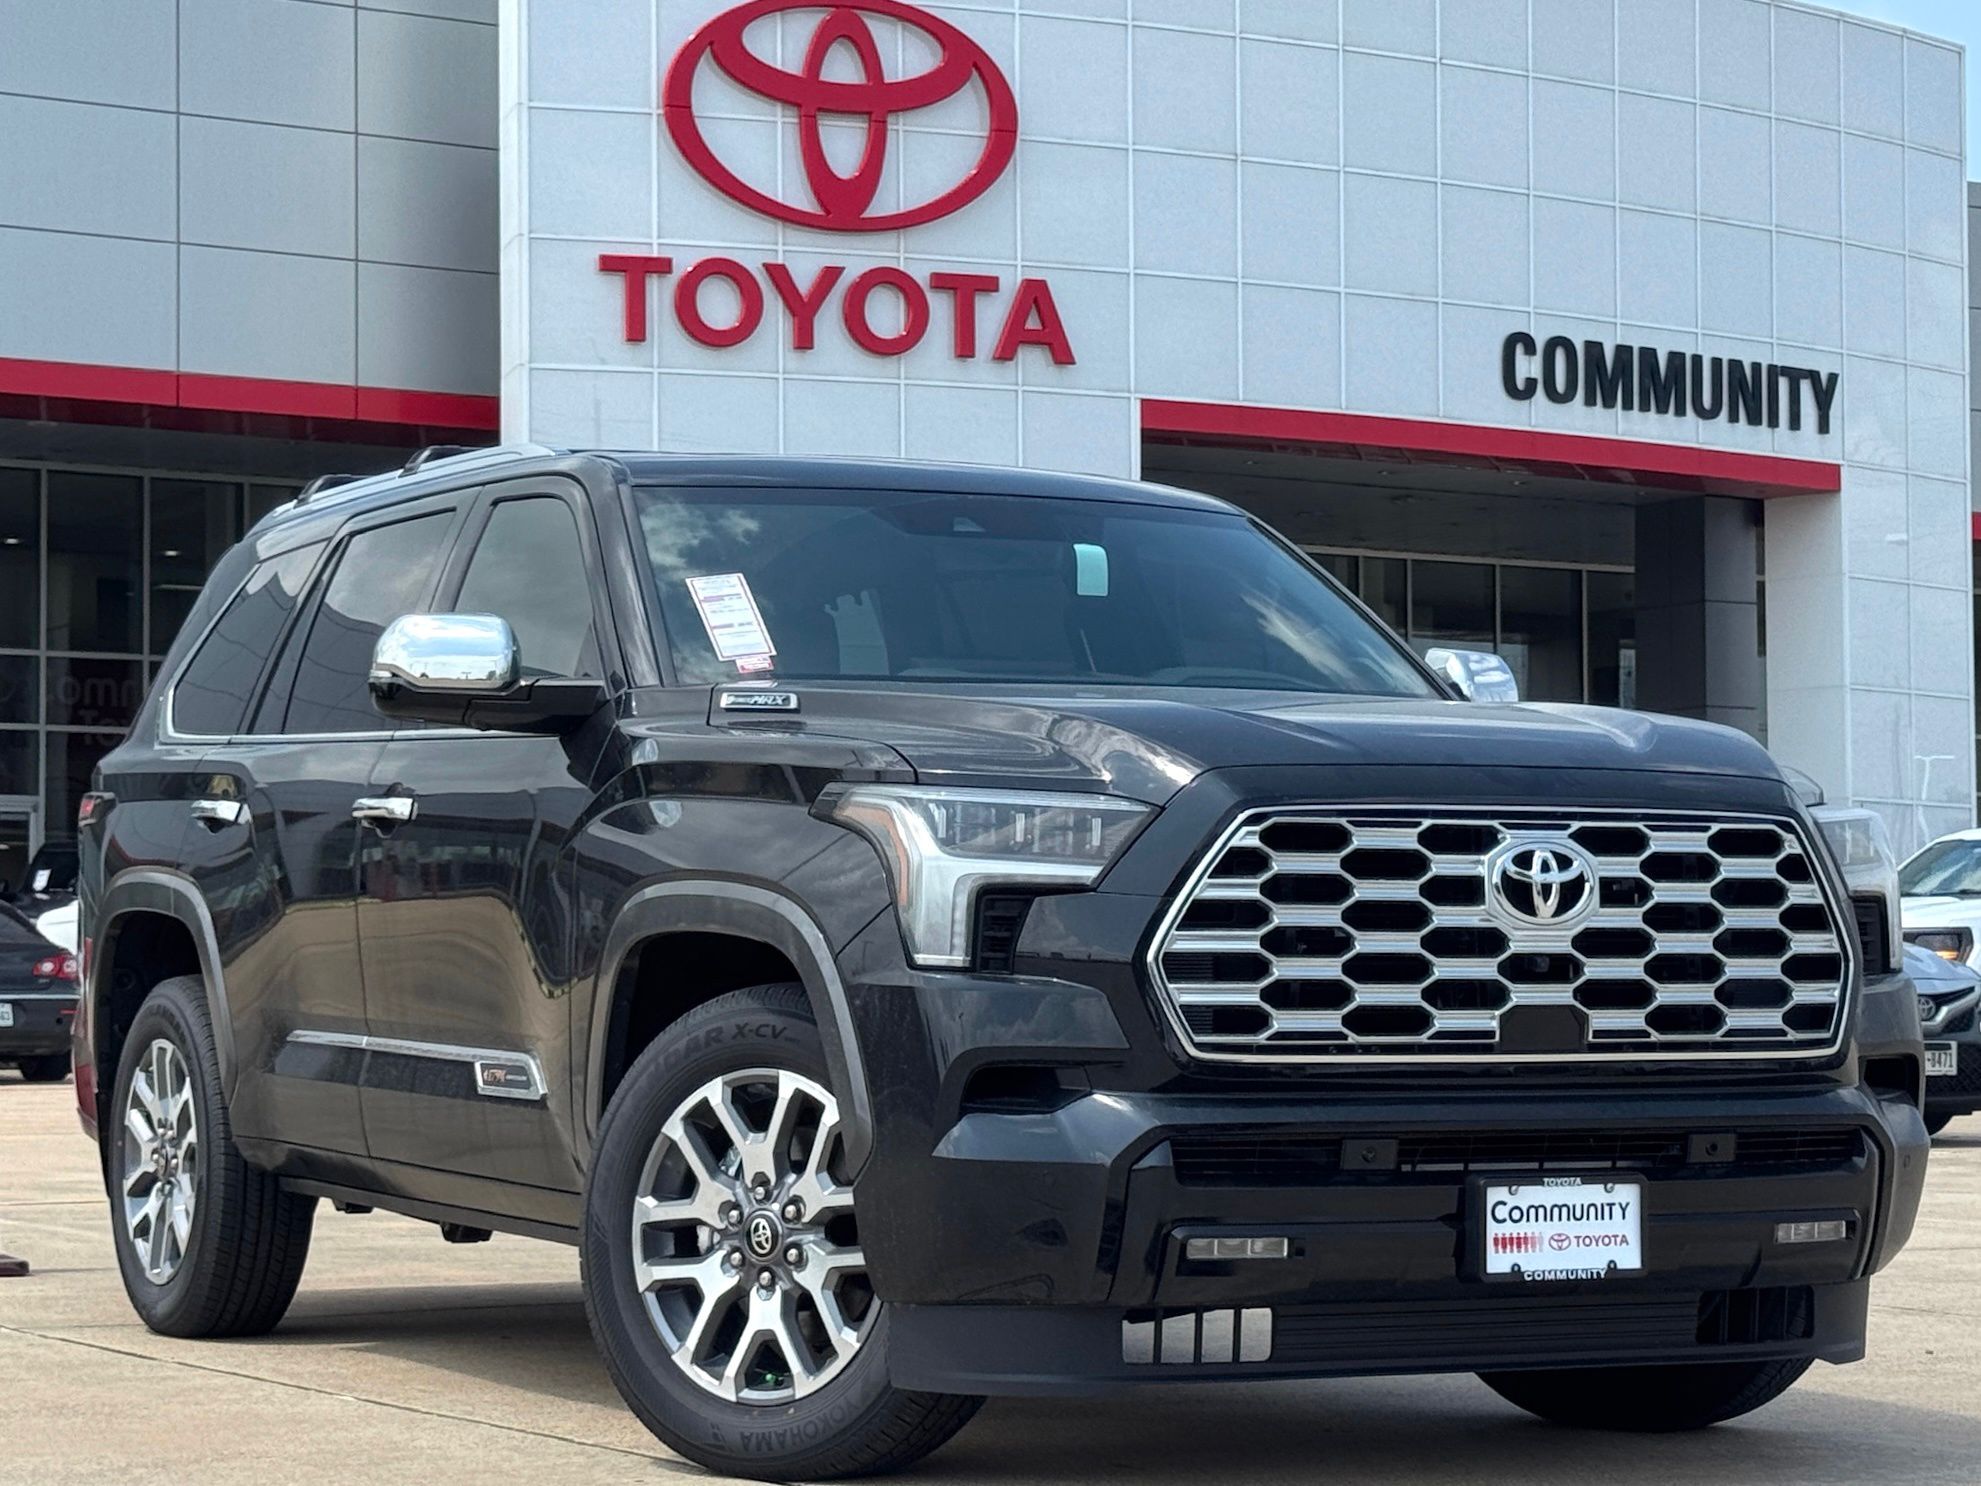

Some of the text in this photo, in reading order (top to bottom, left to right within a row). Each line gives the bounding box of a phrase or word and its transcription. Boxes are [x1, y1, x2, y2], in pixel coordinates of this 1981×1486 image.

[599, 253, 1076, 366] TOYOTA
[1502, 331, 1840, 435] COMMUNITY
[1542, 1177, 1582, 1187] TOYOTA
[1574, 1234, 1629, 1247] TOYOTA
[1524, 1269, 1608, 1282] COMMUNITY
[739, 1397, 864, 1453] YOKOHAMA
